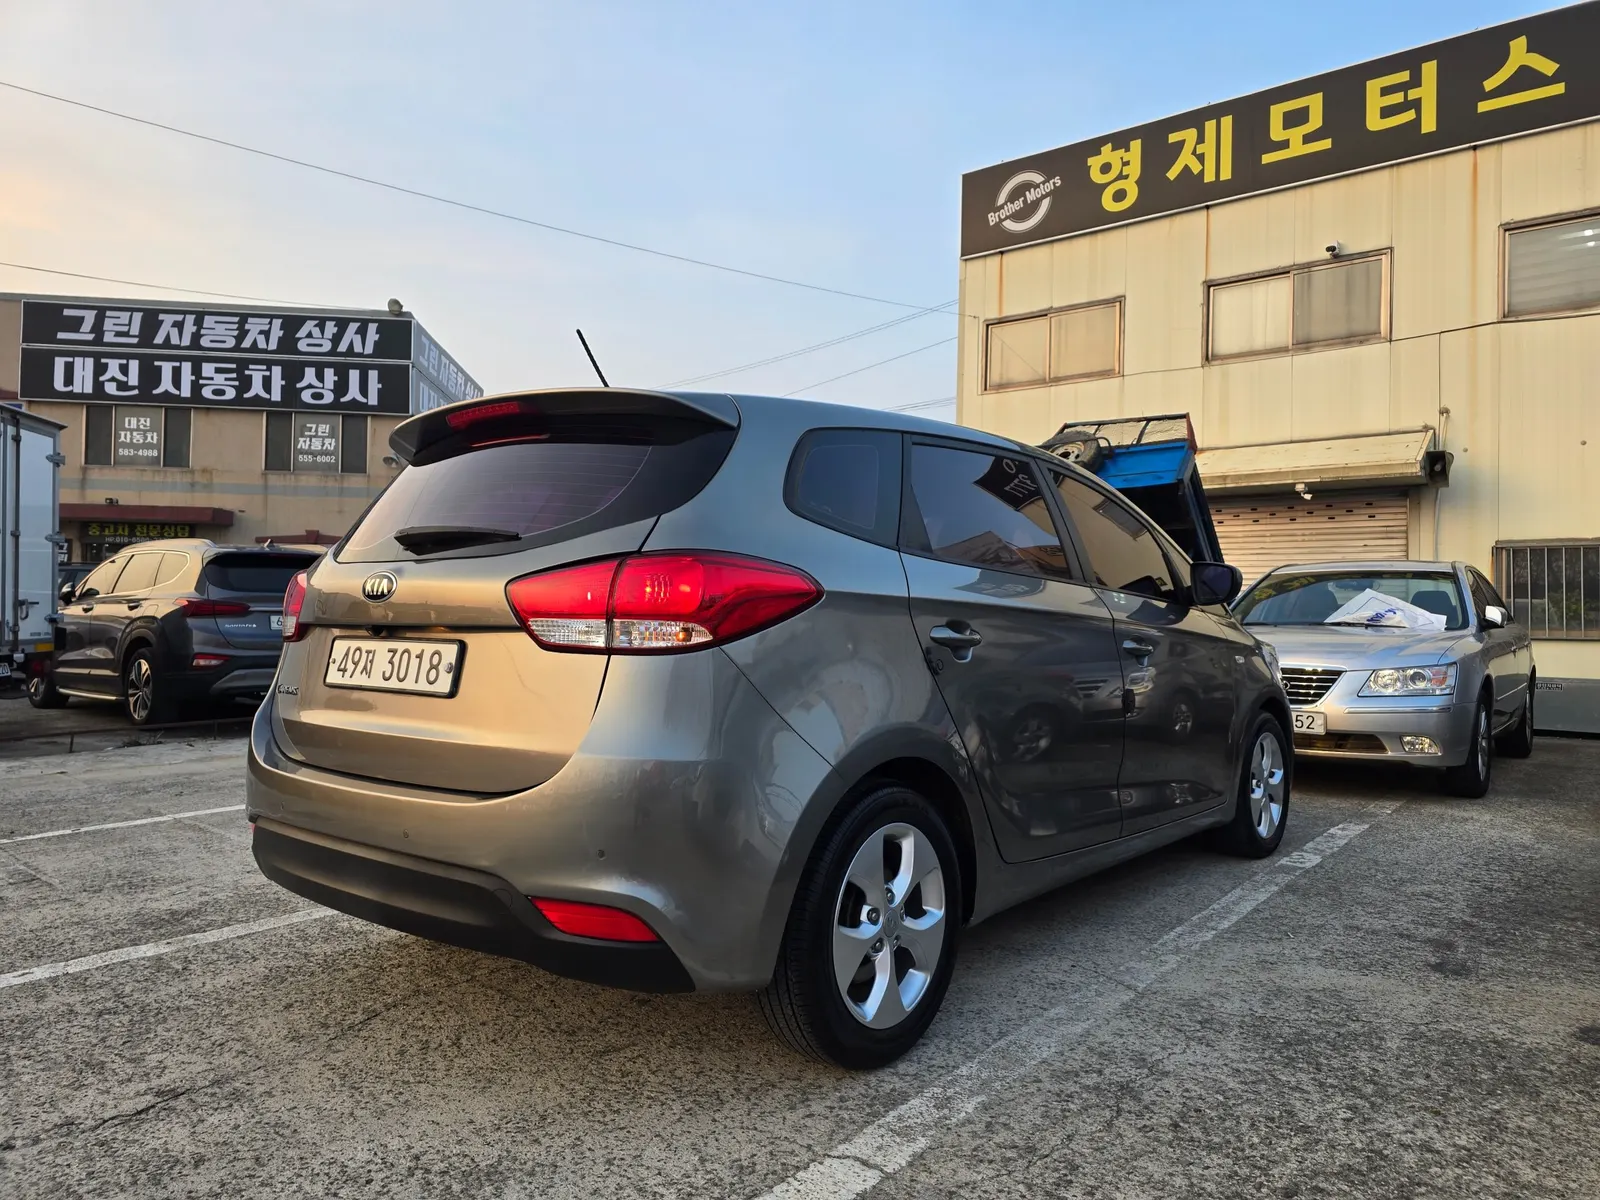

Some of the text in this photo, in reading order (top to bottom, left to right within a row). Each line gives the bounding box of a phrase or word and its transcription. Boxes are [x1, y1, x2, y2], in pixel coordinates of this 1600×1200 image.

[1087, 35, 1566, 213] 형제모터스
[987, 175, 1062, 226] Brother Motors
[56, 308, 381, 356] 그린 자동차 상사
[53, 356, 382, 406] 대진 자동차 상사
[124, 416, 151, 430] 대진
[304, 423, 330, 436] 그린
[118, 430, 159, 444] 자동차
[297, 437, 336, 450] 자동차
[118, 447, 158, 457] 583-4988
[298, 454, 336, 463] 555-6002
[365, 578, 389, 596] KIA
[336, 645, 443, 686] 49저 3018
[1294, 714, 1315, 730] 52
